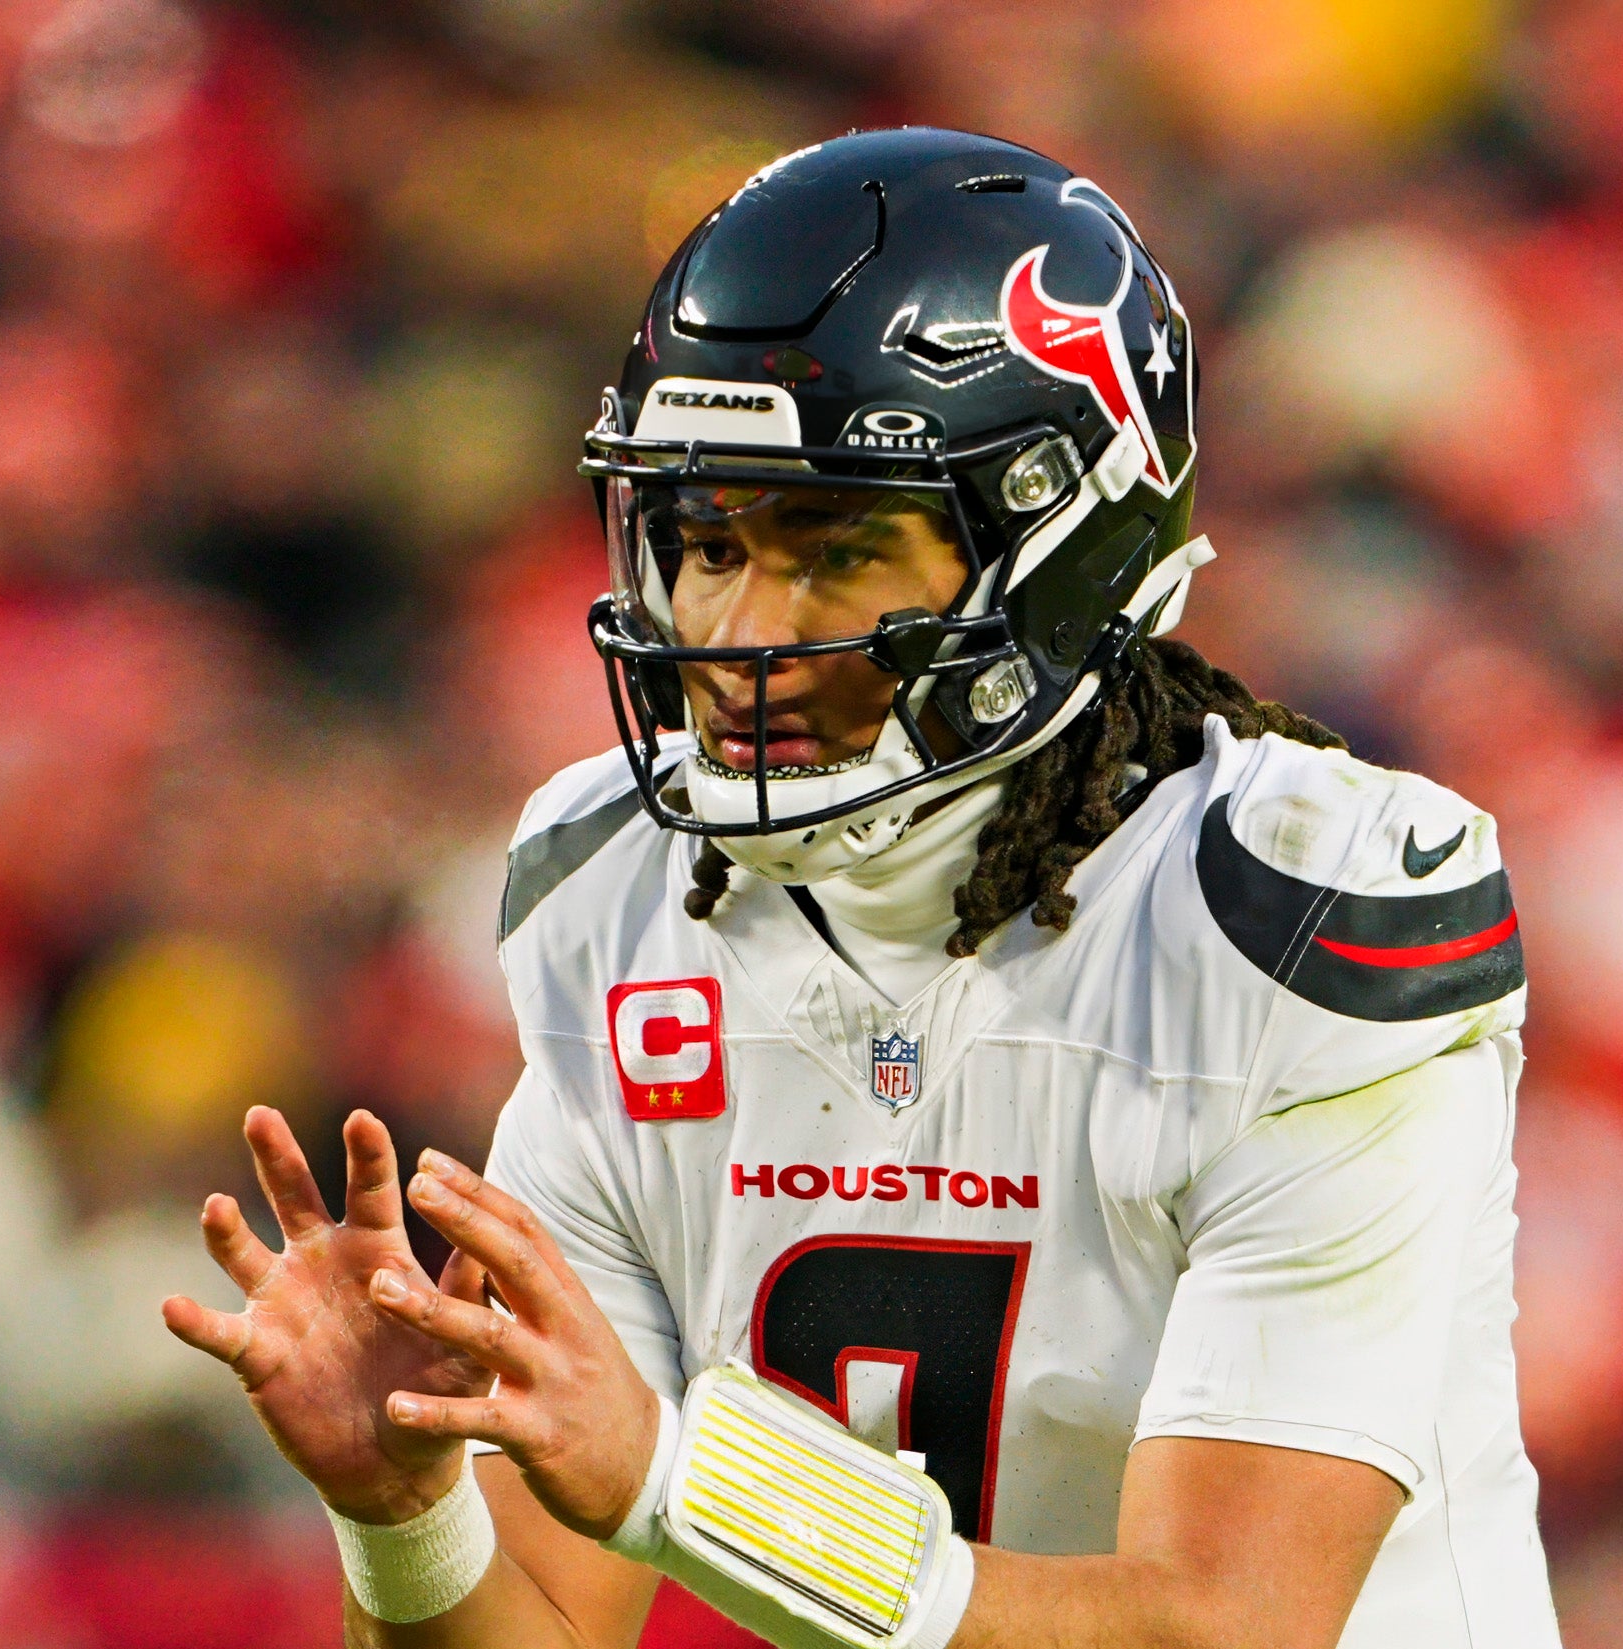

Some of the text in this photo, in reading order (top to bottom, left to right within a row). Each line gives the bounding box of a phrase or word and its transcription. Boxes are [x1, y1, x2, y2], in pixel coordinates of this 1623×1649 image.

[656, 391, 775, 411] TEXANS
[847, 434, 939, 449] OAKLEY
[615, 987, 711, 1084] C
[877, 1065, 912, 1098] NFL
[731, 1163, 1039, 1208] HOUSTON
